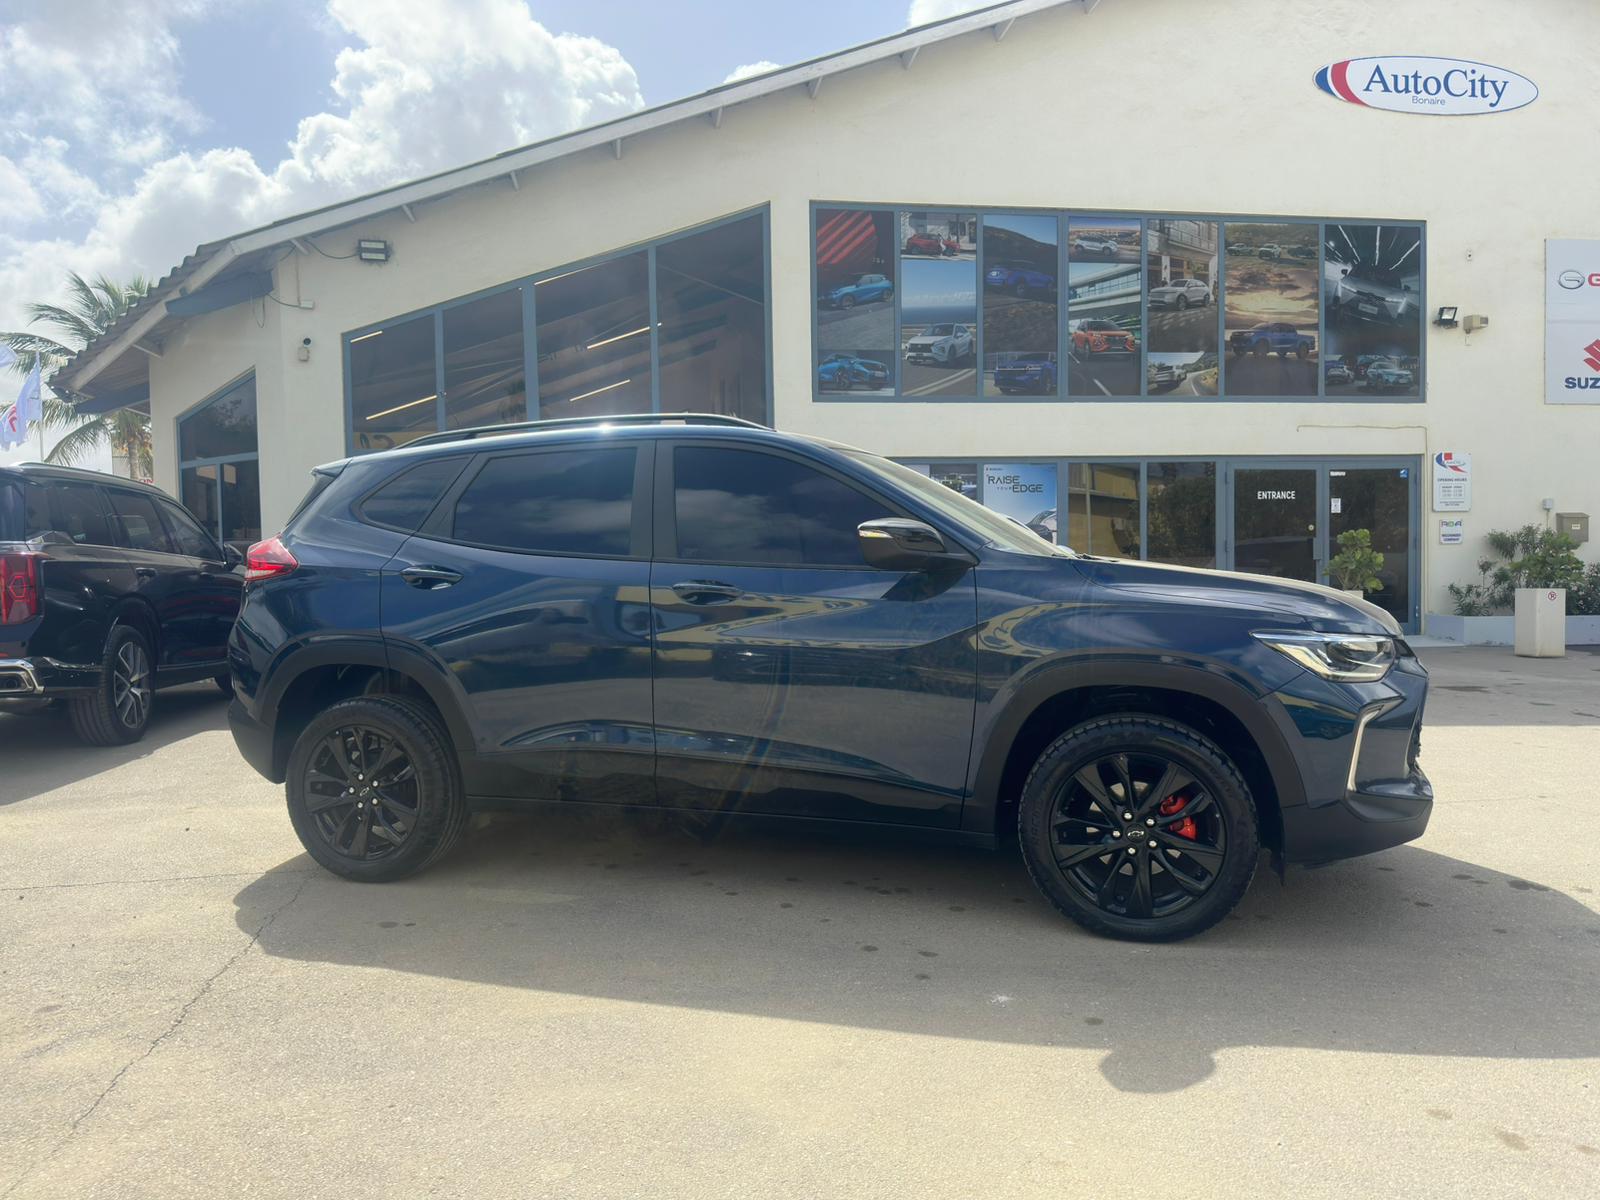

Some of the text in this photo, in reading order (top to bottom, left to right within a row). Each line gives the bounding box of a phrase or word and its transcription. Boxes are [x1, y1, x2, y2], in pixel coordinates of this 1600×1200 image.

[1363, 64, 1509, 107] AutoCity
[1412, 96, 1446, 106] Bonaire
[1565, 377, 1600, 390] SUZ
[988, 475, 1020, 485] RAISE
[1012, 484, 1044, 493] EDGE
[1257, 490, 1296, 500] ENTRANCE
